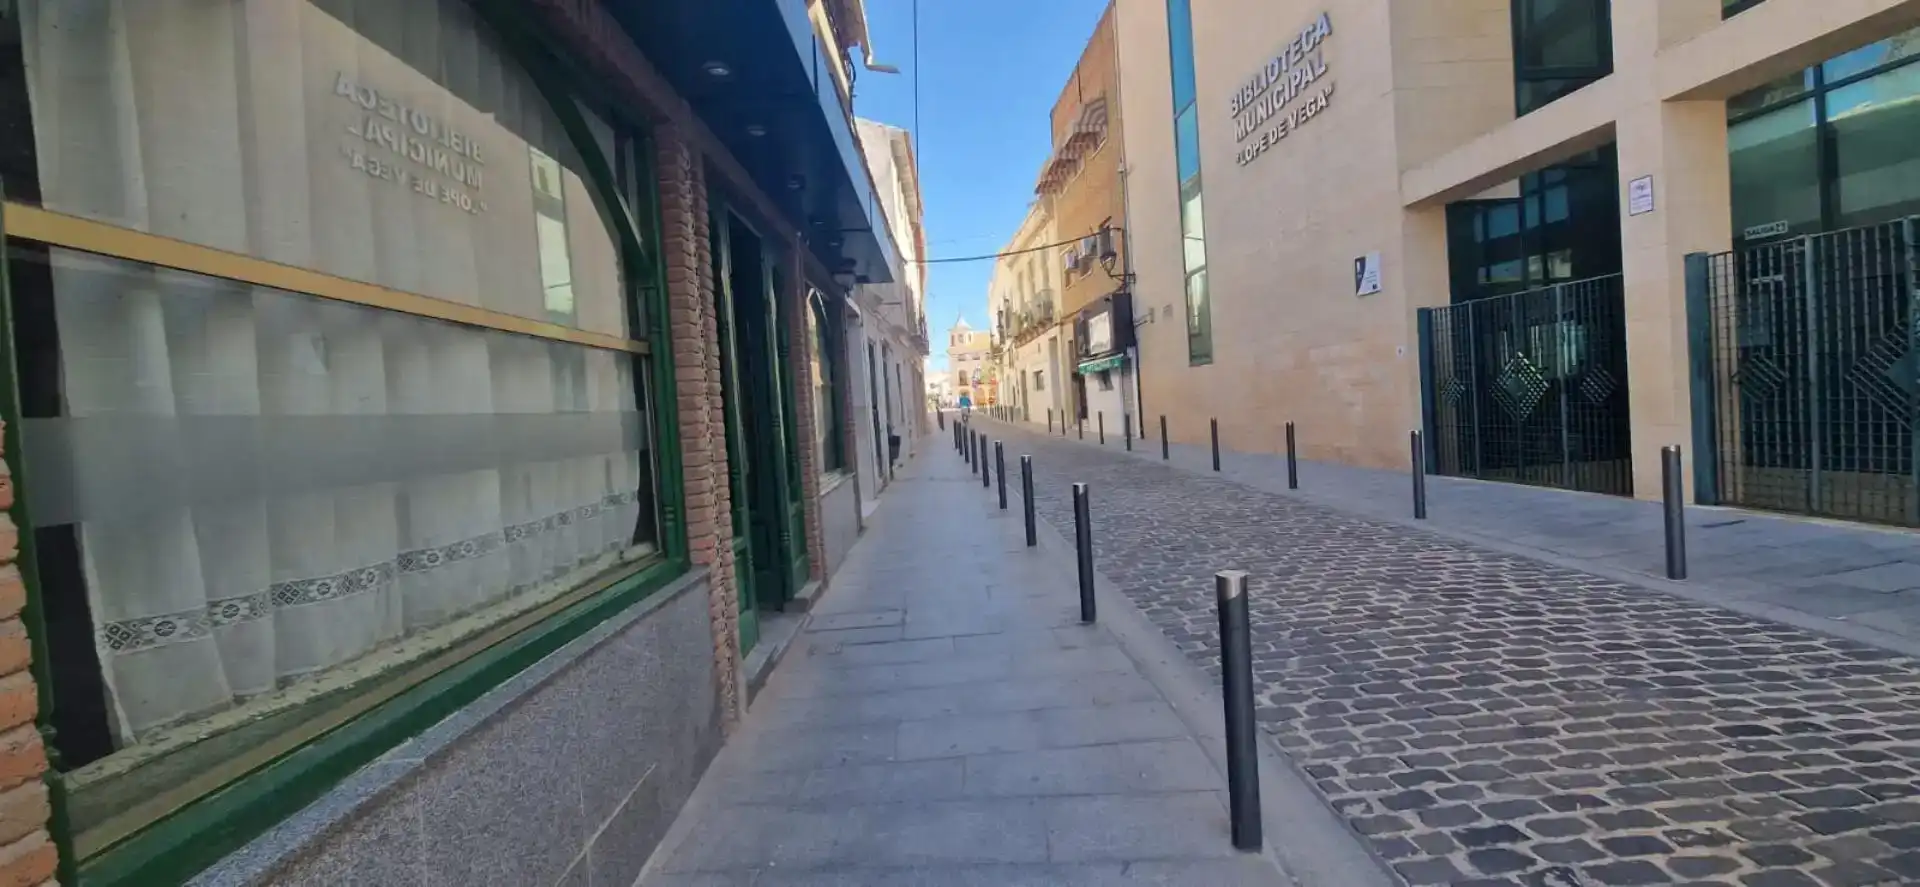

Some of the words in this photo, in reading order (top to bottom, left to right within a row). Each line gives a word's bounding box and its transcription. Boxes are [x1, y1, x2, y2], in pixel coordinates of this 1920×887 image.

[1230, 11, 1333, 119] BIBLIOTECA
[1234, 49, 1328, 143] MUNICIPAL
[1269, 118, 1289, 145] DE
